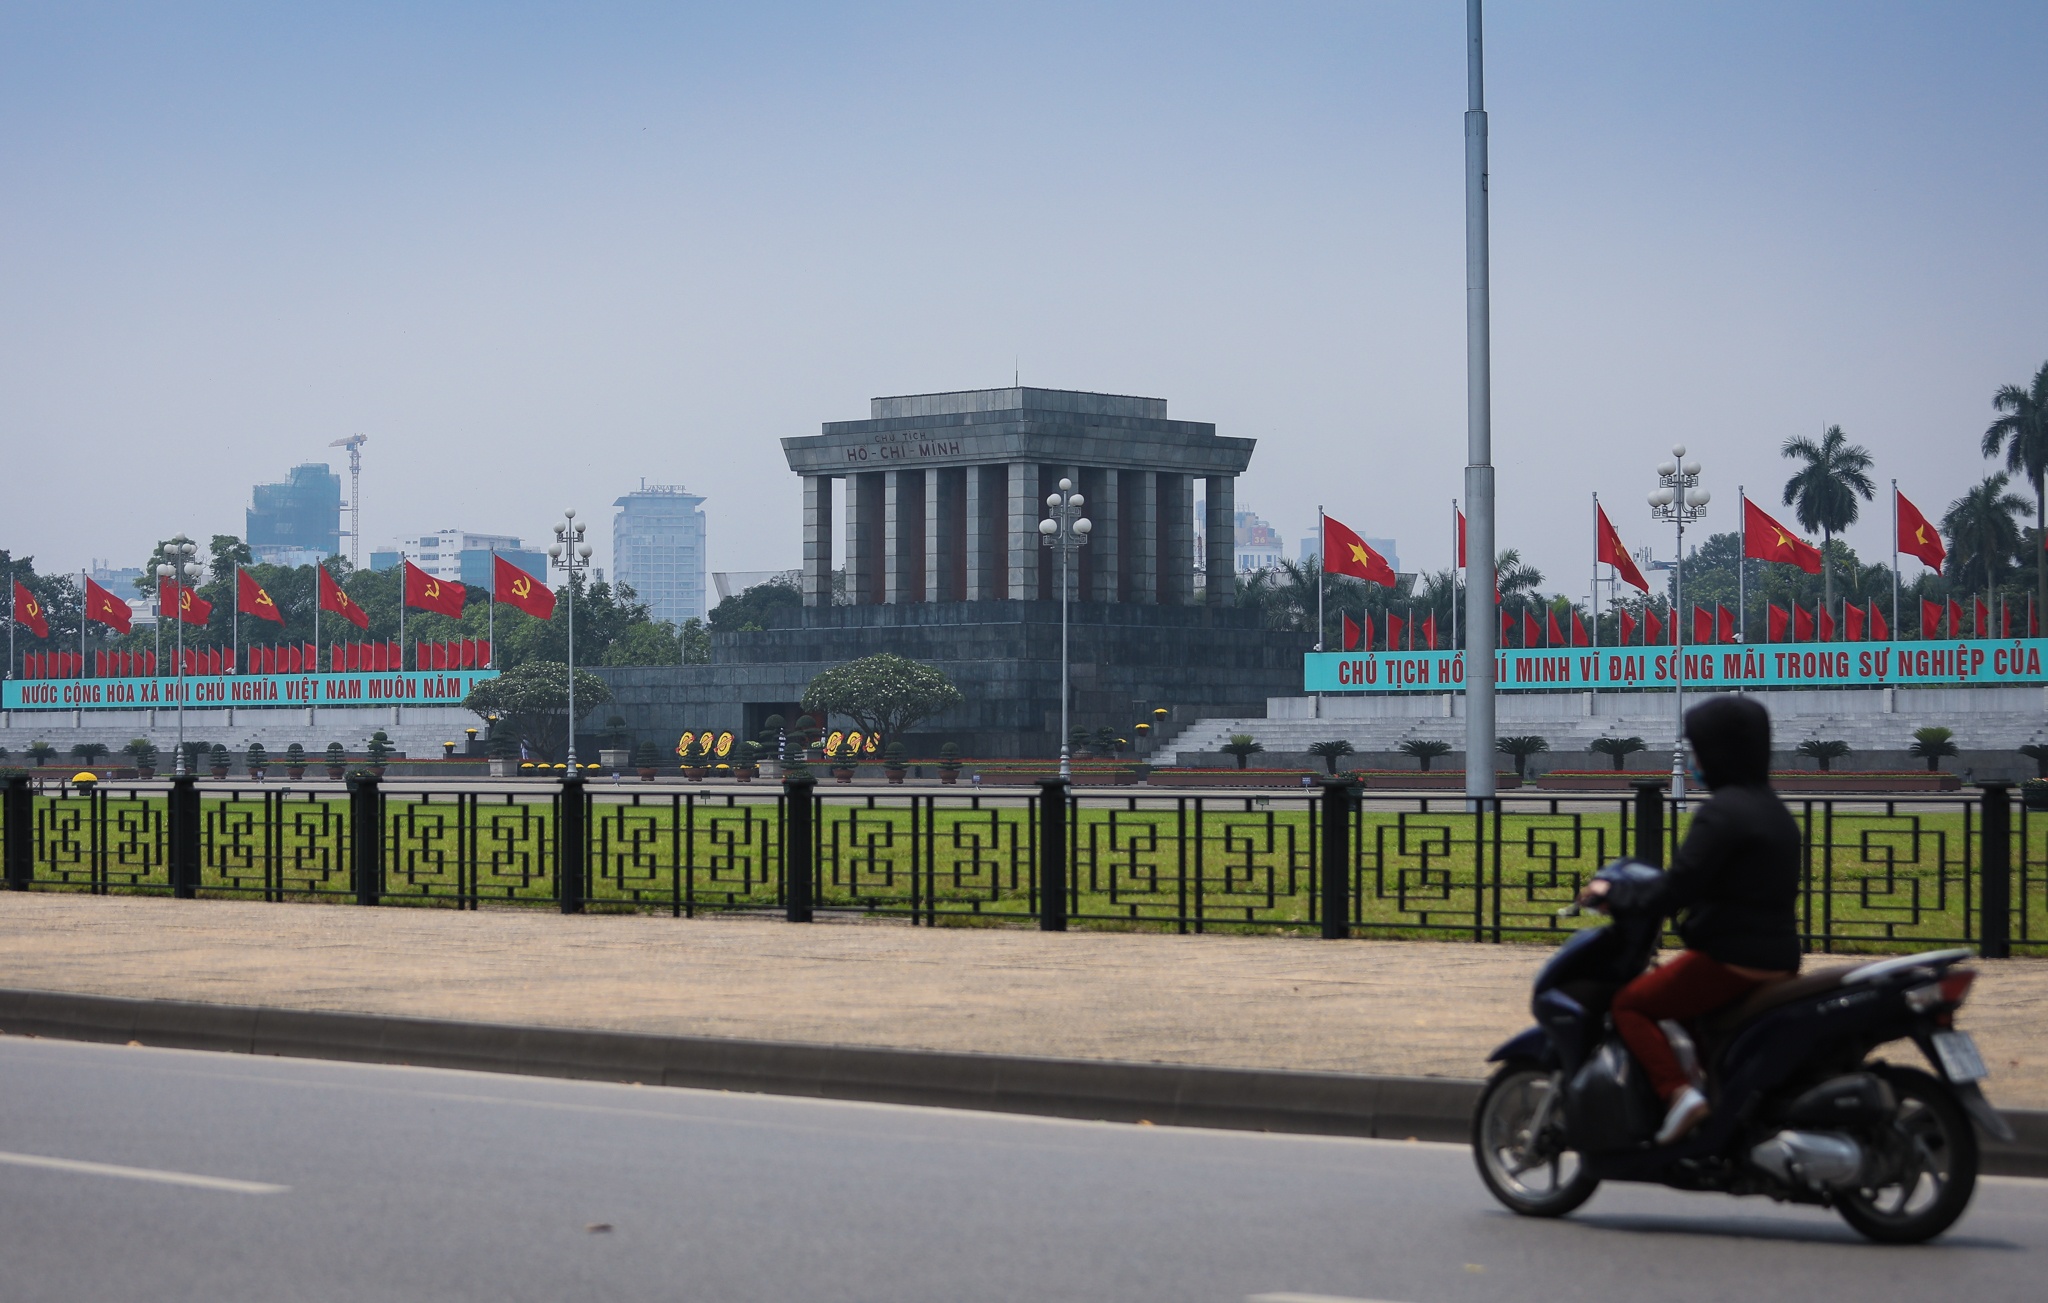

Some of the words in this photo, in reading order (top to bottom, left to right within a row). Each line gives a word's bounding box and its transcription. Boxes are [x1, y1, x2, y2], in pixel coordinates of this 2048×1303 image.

[1338, 653, 1377, 685] CHỦ
[1385, 659, 1430, 689] TỊCH
[1438, 651, 1464, 685] HỒ
[1516, 656, 1570, 683] MINH
[1579, 651, 1600, 682] VĨ
[1608, 655, 1645, 685] ĐẠI
[1723, 648, 1765, 680] MÃI
[1774, 651, 1849, 680] TRONG
[1858, 647, 1890, 682] SỰ
[1898, 643, 1985, 681] NGHIỆP
[1993, 639, 2041, 675] CỦA
[21, 681, 58, 704] NƯỚC
[63, 681, 101, 707] CỘNG
[106, 680, 135, 703] HÒA
[140, 680, 159, 702] XÃ
[196, 677, 225, 701] CHỦ
[231, 677, 279, 701] NGHĨA
[285, 676, 319, 703] VIỆT
[326, 679, 362, 700] NAM
[368, 675, 416, 699] MUÔN
[423, 674, 461, 699] NĂM
